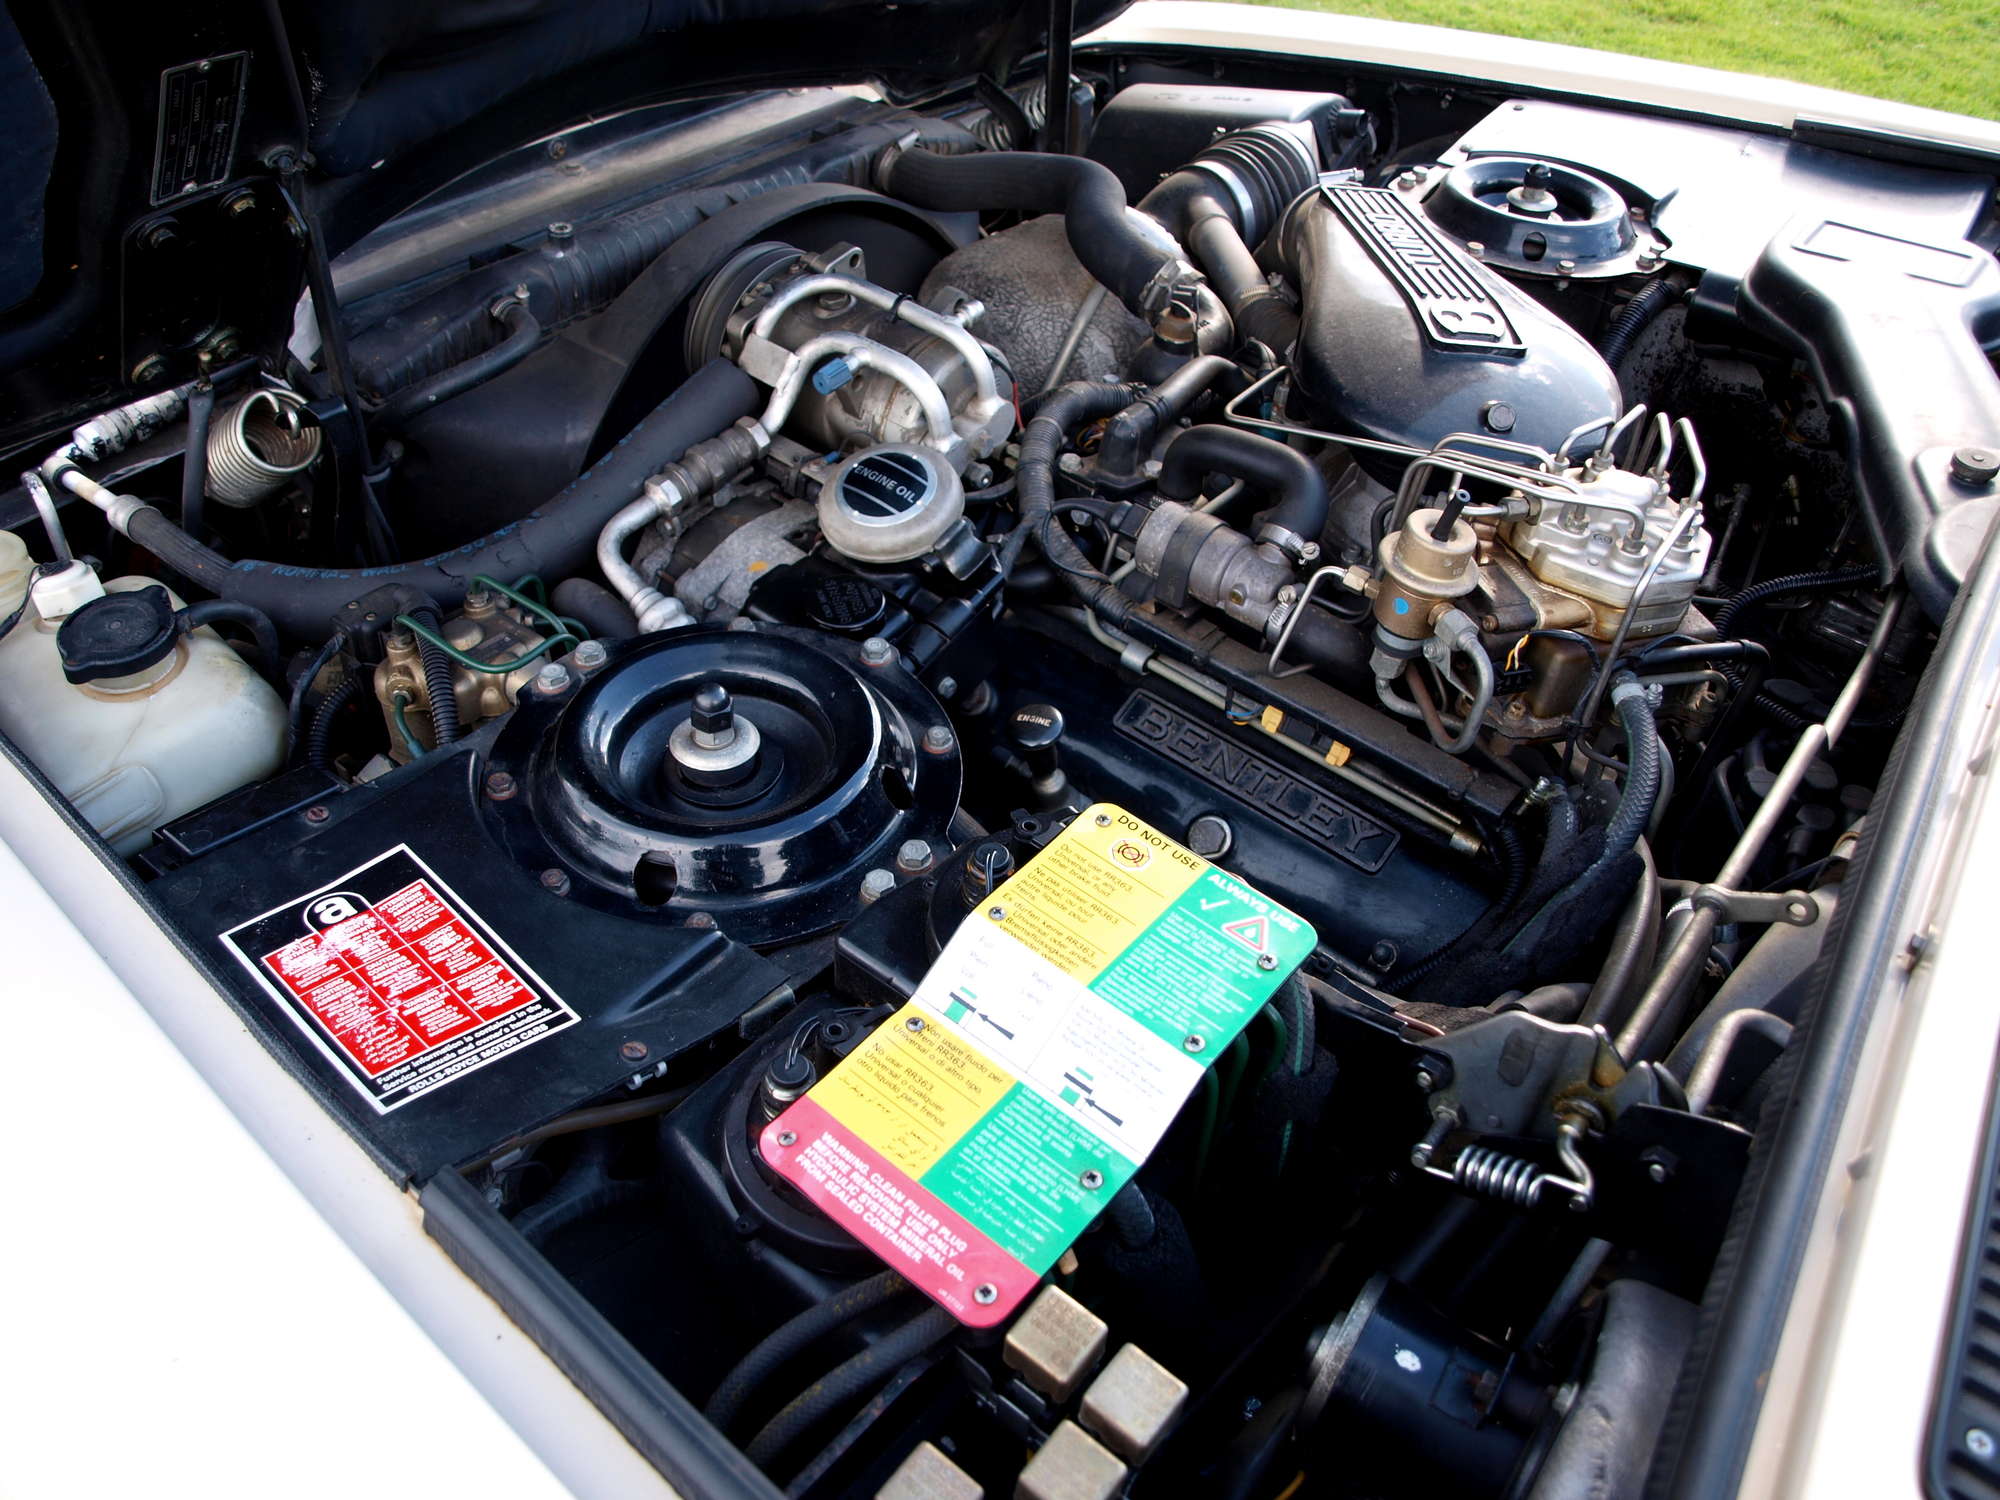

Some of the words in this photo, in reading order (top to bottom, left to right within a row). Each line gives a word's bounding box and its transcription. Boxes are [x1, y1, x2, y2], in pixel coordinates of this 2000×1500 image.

[854, 465, 898, 490] ENGINE
[895, 485, 916, 503] OIL
[1017, 714, 1052, 727] ENGINE
[1131, 709, 1384, 854] BENTLEY
[1117, 814, 1139, 832] DO
[1140, 830, 1172, 853] NOT
[1171, 849, 1201, 871] USE
[315, 895, 358, 925] a
[1206, 871, 1270, 915] ALWAYS
[1267, 908, 1301, 934] USE
[375, 1063, 412, 1084] Further
[410, 1038, 465, 1068] information
[462, 1034, 474, 1043] is
[471, 1013, 517, 1039] contained
[514, 1009, 527, 1018] in
[524, 1002, 542, 1013] the
[381, 1069, 419, 1091] Service
[416, 1051, 458, 1074] manuals
[454, 1042, 476, 1055] and
[508, 1005, 553, 1030] handbook
[406, 1053, 482, 1093] ROLLS-ROYCE
[478, 1035, 521, 1059] MOTOR
[517, 1022, 549, 1041] CARS
[794, 1154, 828, 1183] FROM
[823, 1178, 866, 1215] SEALED
[802, 1146, 861, 1196] HYDRAULIC
[856, 1191, 902, 1229] SYSTEM
[897, 1224, 949, 1267] MINERAL
[944, 1261, 967, 1282] OIL
[810, 1138, 853, 1174] BEFORE
[903, 1214, 929, 1236] USE
[925, 1232, 959, 1260] ONLY
[868, 1171, 907, 1203] CLEAN
[902, 1198, 941, 1230] FILLER
[936, 1225, 969, 1252] PLUG
